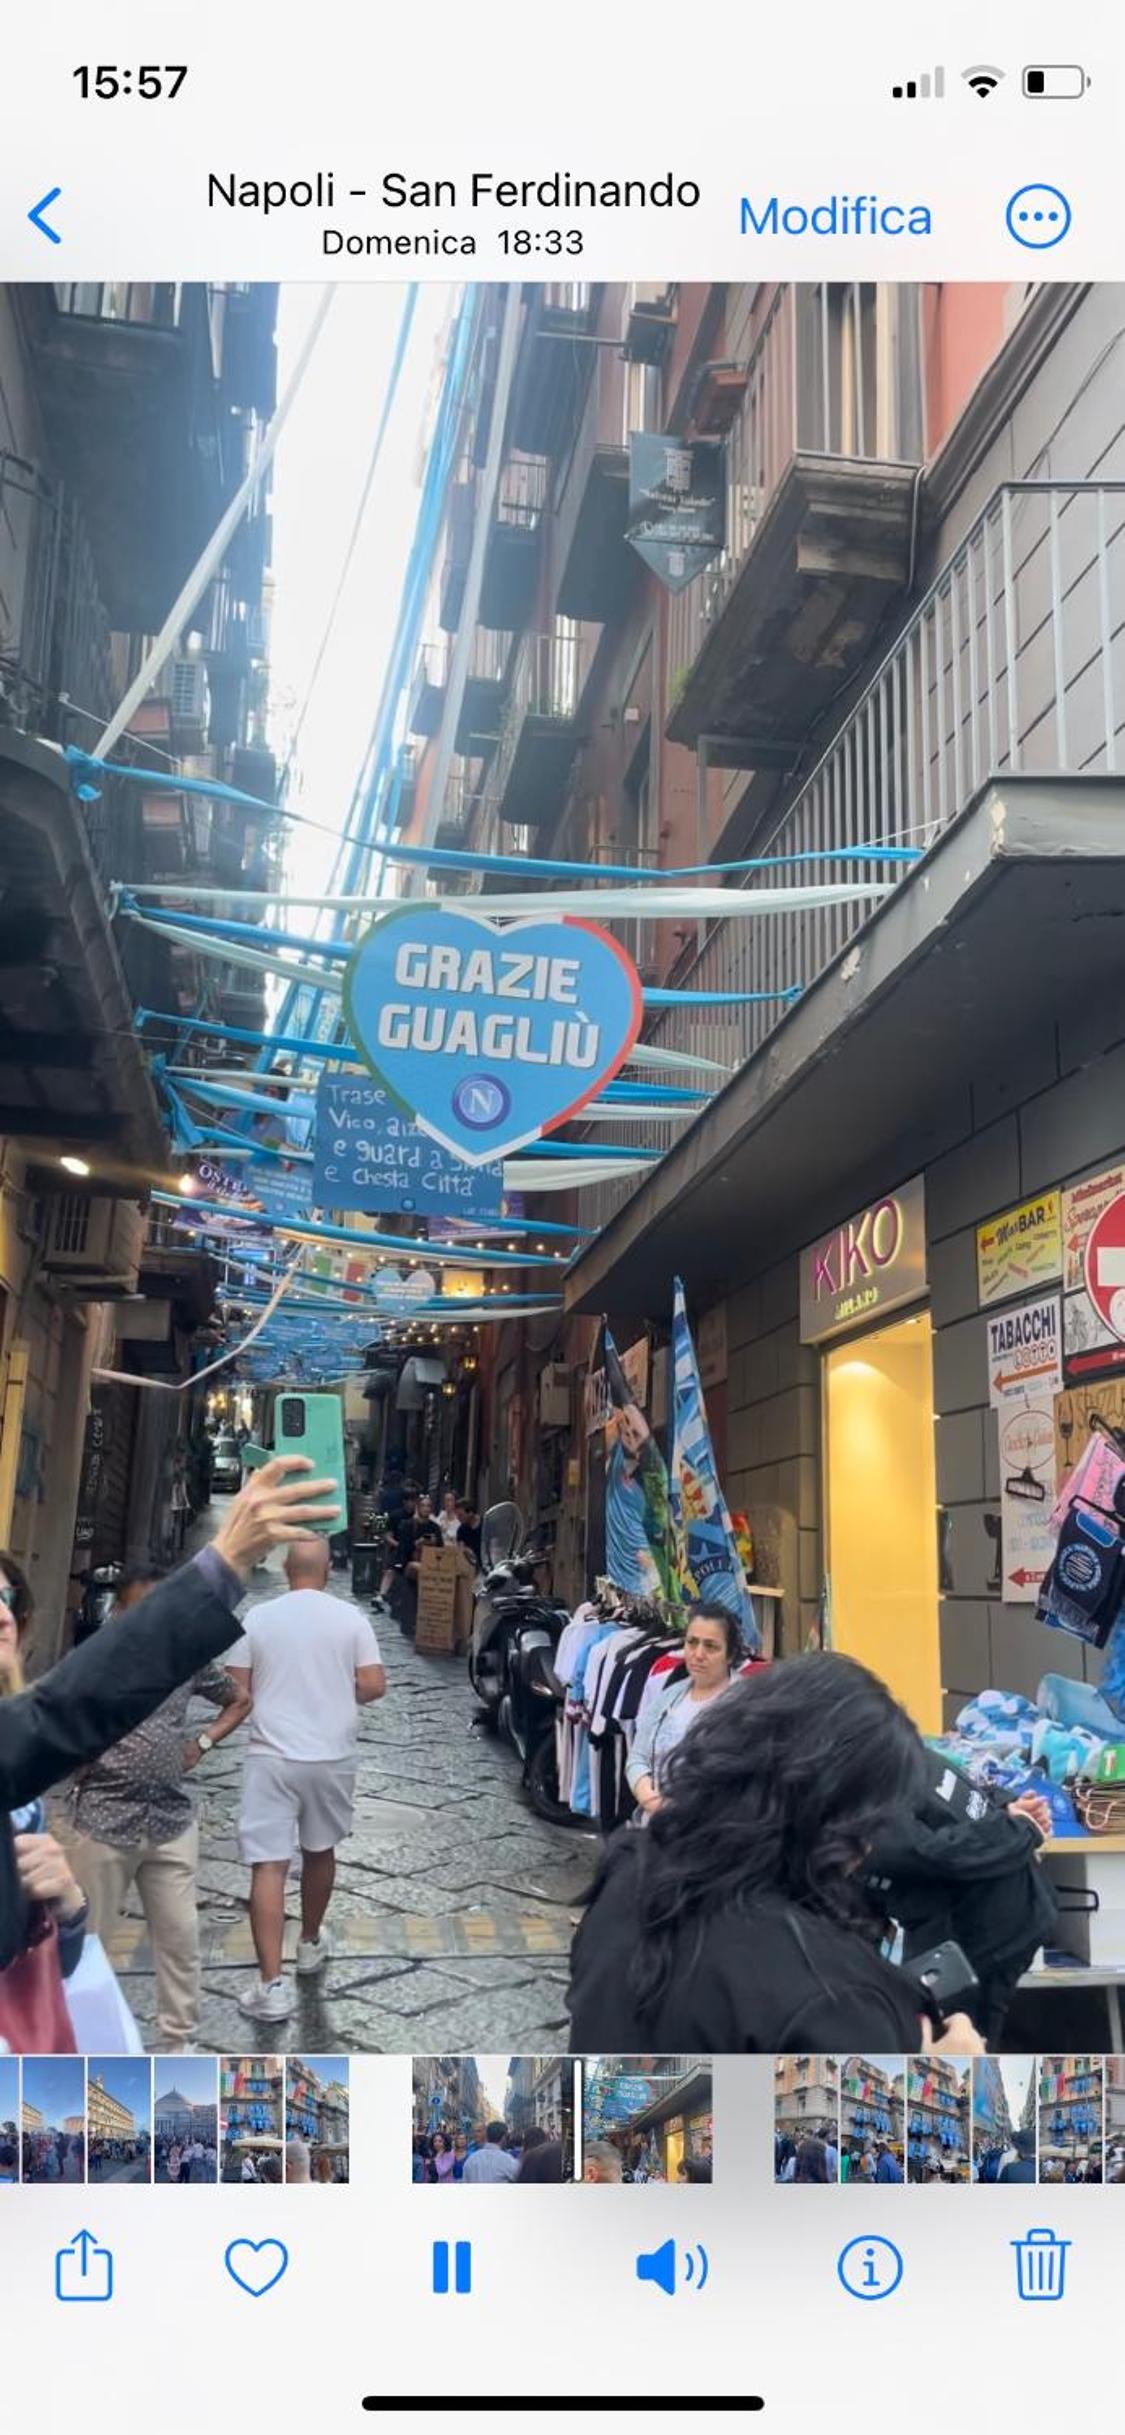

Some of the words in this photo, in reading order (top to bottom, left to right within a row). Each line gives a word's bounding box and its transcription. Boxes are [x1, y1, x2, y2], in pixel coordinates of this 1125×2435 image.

[394, 942, 581, 1004] GRAZIE
[377, 1004, 600, 1068] GUAGLIÙ
[326, 1084, 387, 1106] Trase
[469, 1088, 495, 1115] N
[333, 1139, 347, 1156] e
[324, 1165, 340, 1182] e
[812, 1198, 904, 1303] KIKO
[990, 1303, 1056, 1355] TABACCHI
